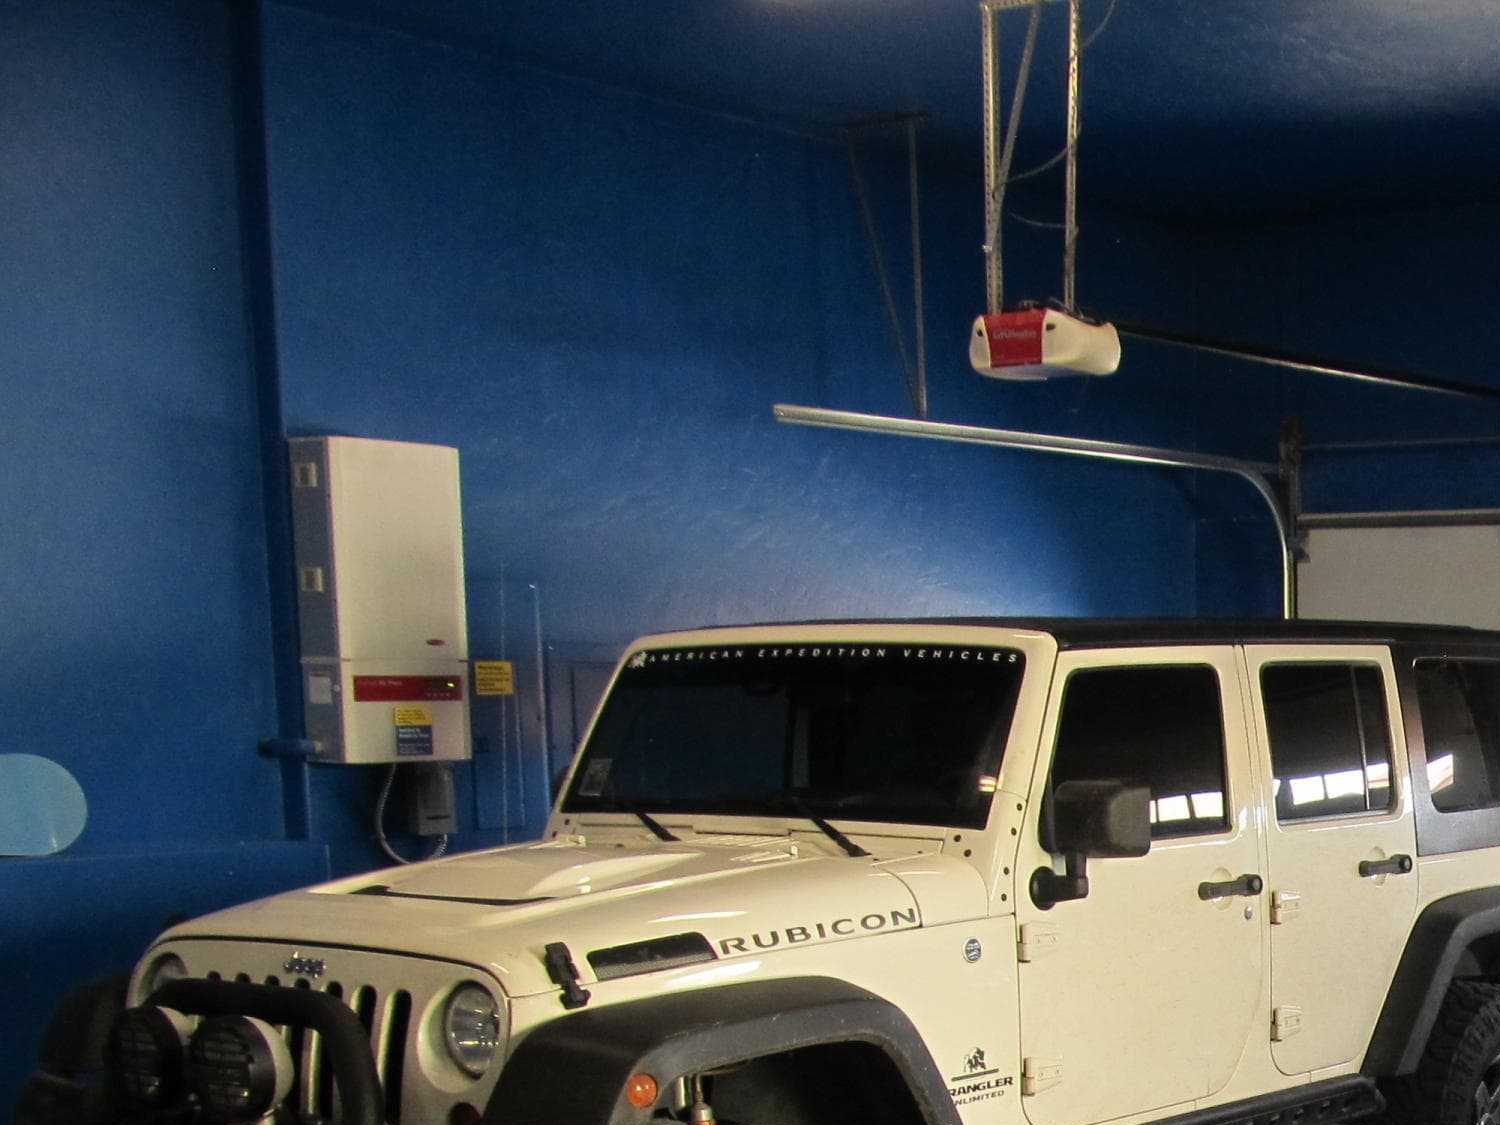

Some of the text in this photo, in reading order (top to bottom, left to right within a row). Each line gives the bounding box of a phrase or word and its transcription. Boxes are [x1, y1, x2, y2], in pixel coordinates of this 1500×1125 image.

[648, 648, 1018, 663] AMERICAN EXPEDITION VEHICLES
[718, 908, 917, 955] RUBICON
[948, 1076, 1014, 1097] RANGLER
[952, 1089, 1005, 1106] NLIMITED
